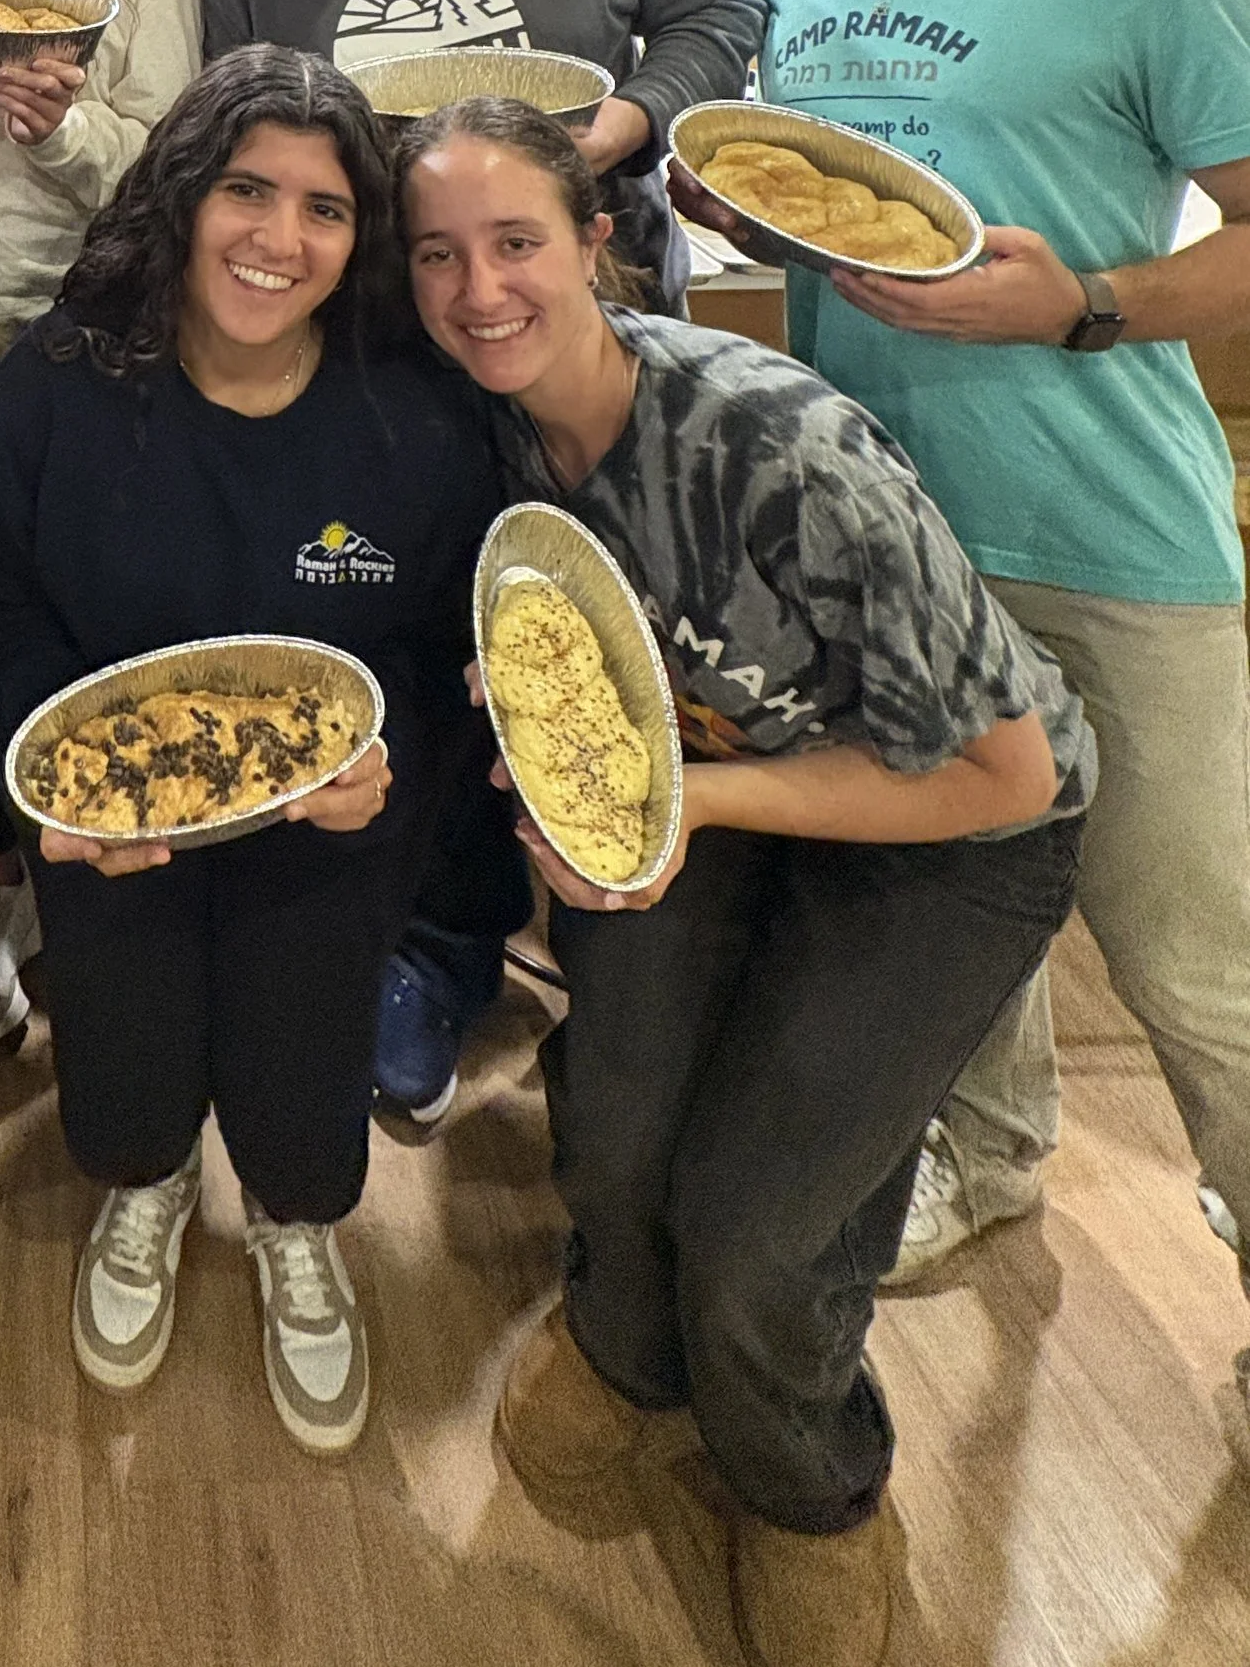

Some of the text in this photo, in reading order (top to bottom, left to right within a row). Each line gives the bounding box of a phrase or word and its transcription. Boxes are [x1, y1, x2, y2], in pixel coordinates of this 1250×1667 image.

[775, 10, 979, 69] CAMP RAMAH
[783, 59, 938, 86] מחנות רמה
[902, 115, 930, 136] do
[642, 593, 817, 724] AMAH
